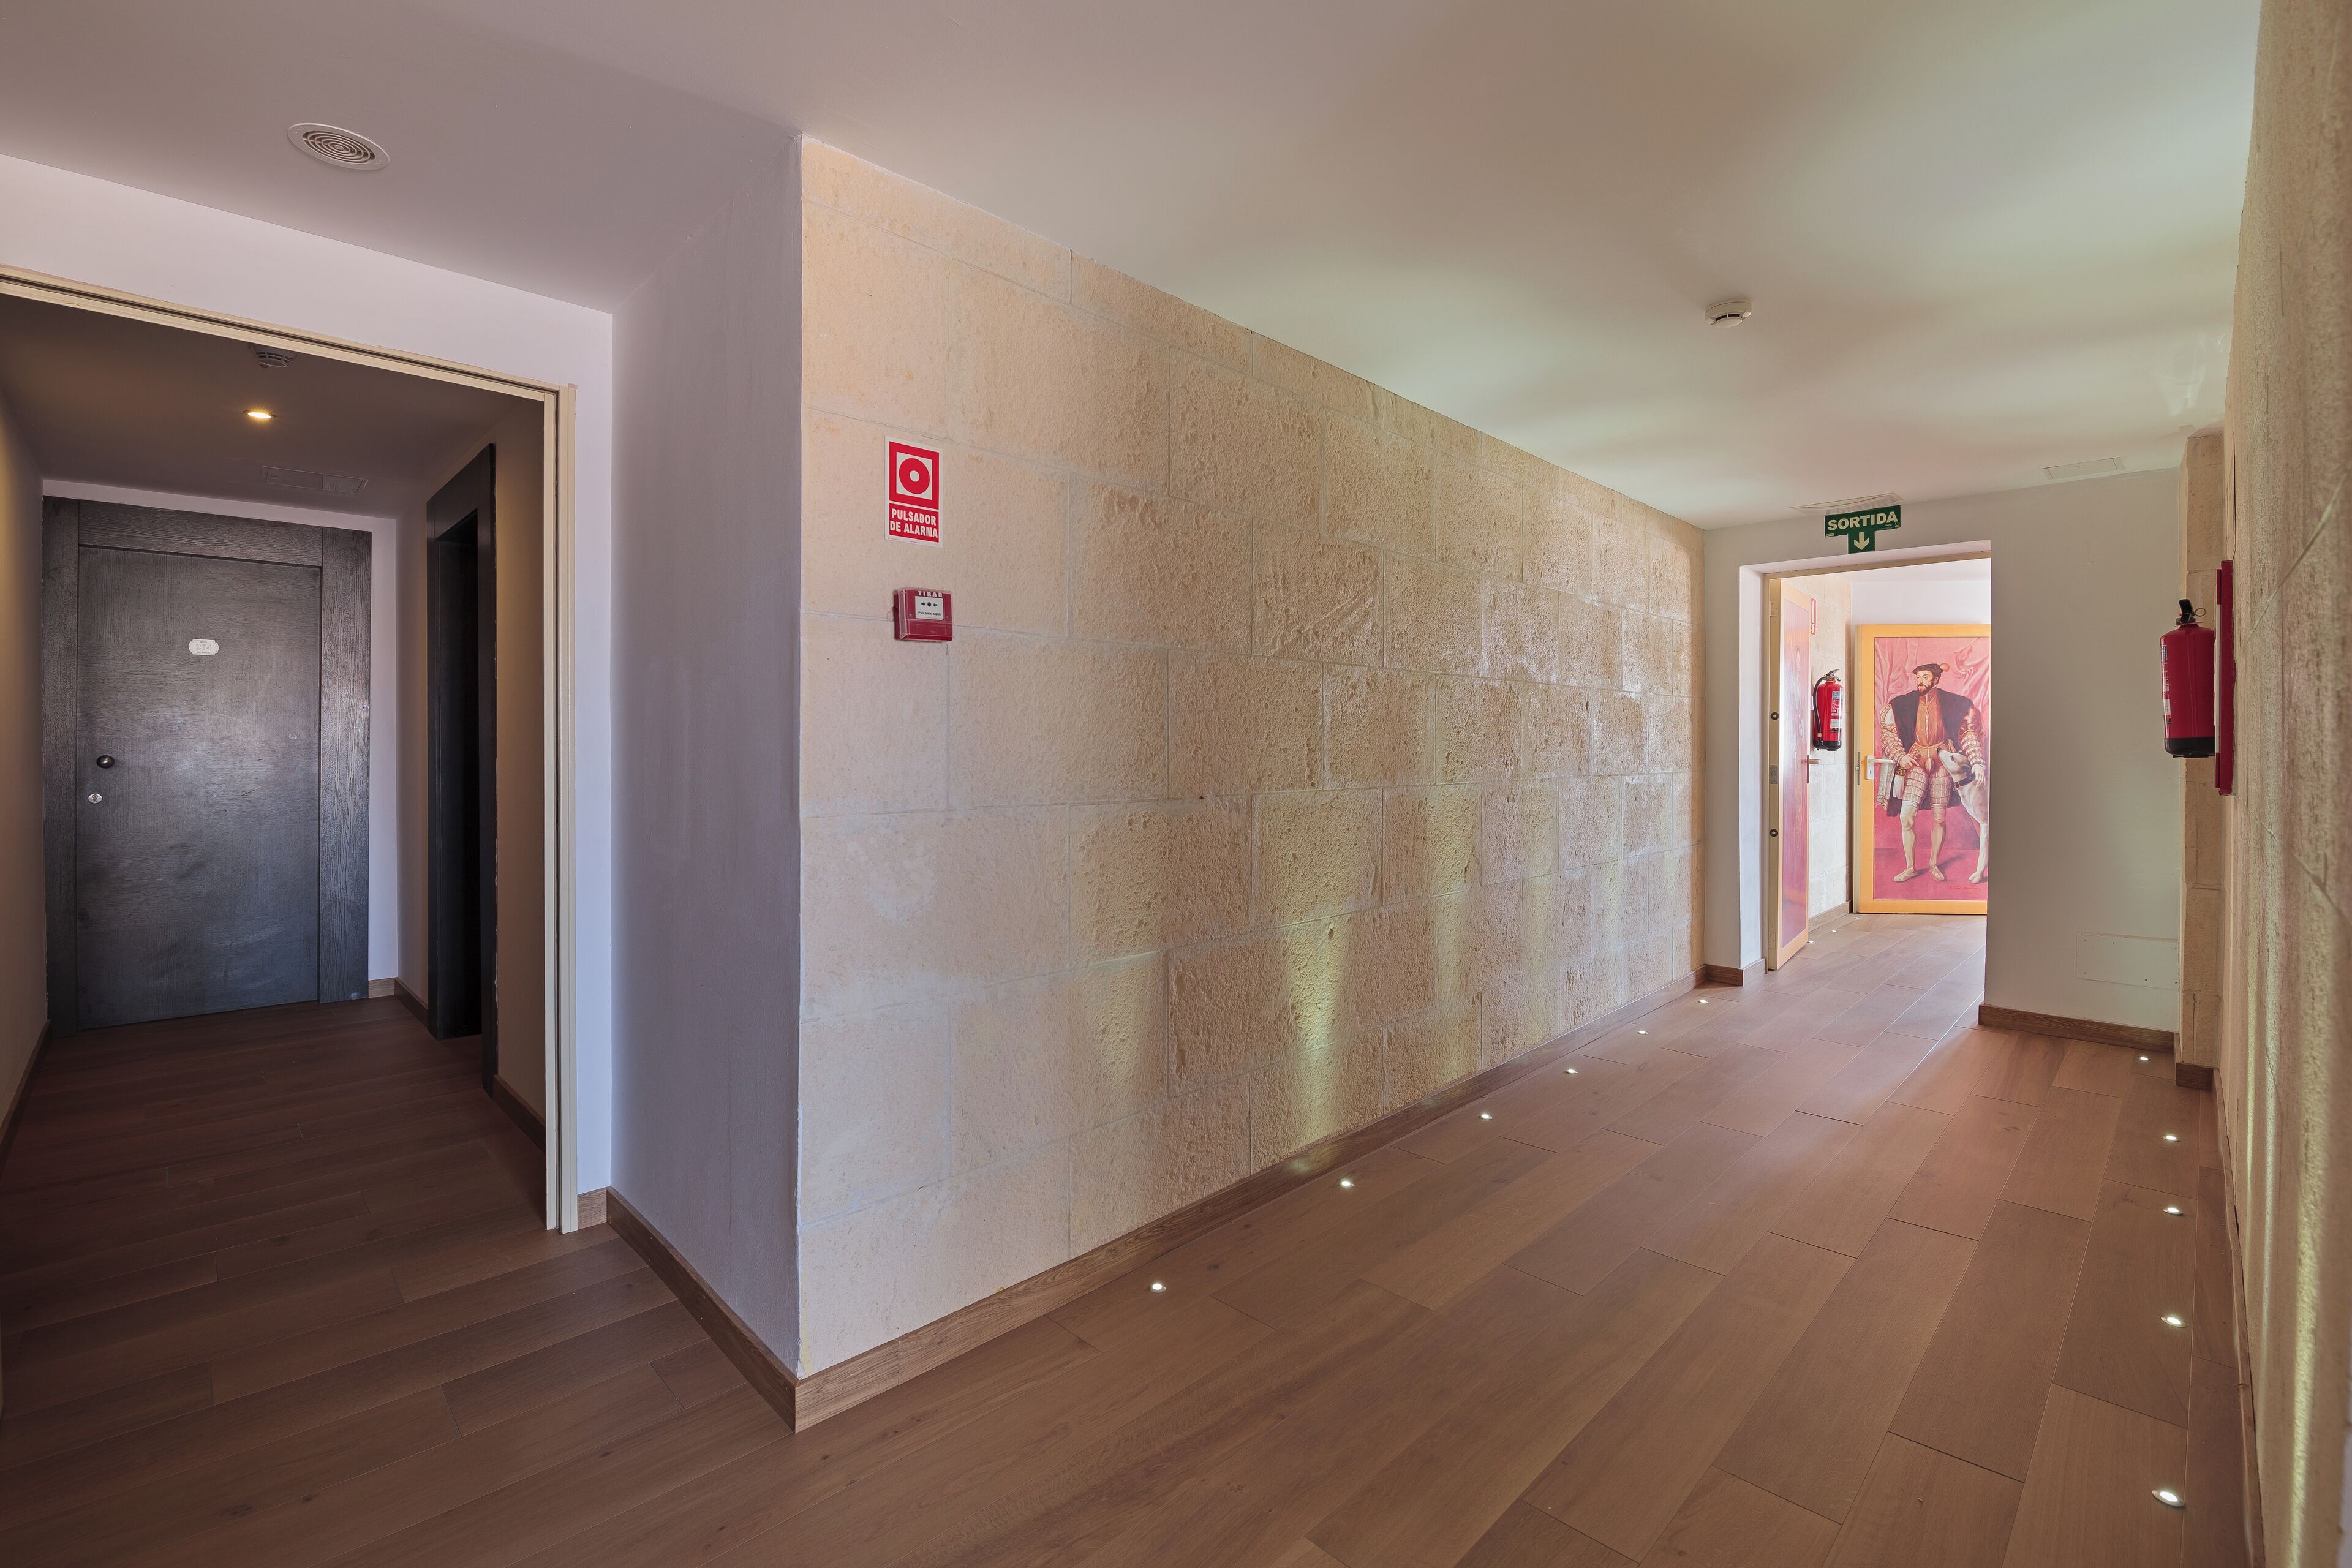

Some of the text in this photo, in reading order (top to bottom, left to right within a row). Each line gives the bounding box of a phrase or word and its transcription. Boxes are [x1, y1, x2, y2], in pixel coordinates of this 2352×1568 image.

[892, 508, 937, 526] PULSADOR
[1828, 511, 1898, 531] SORTIDA
[890, 520, 938, 538] DE ALARMA
